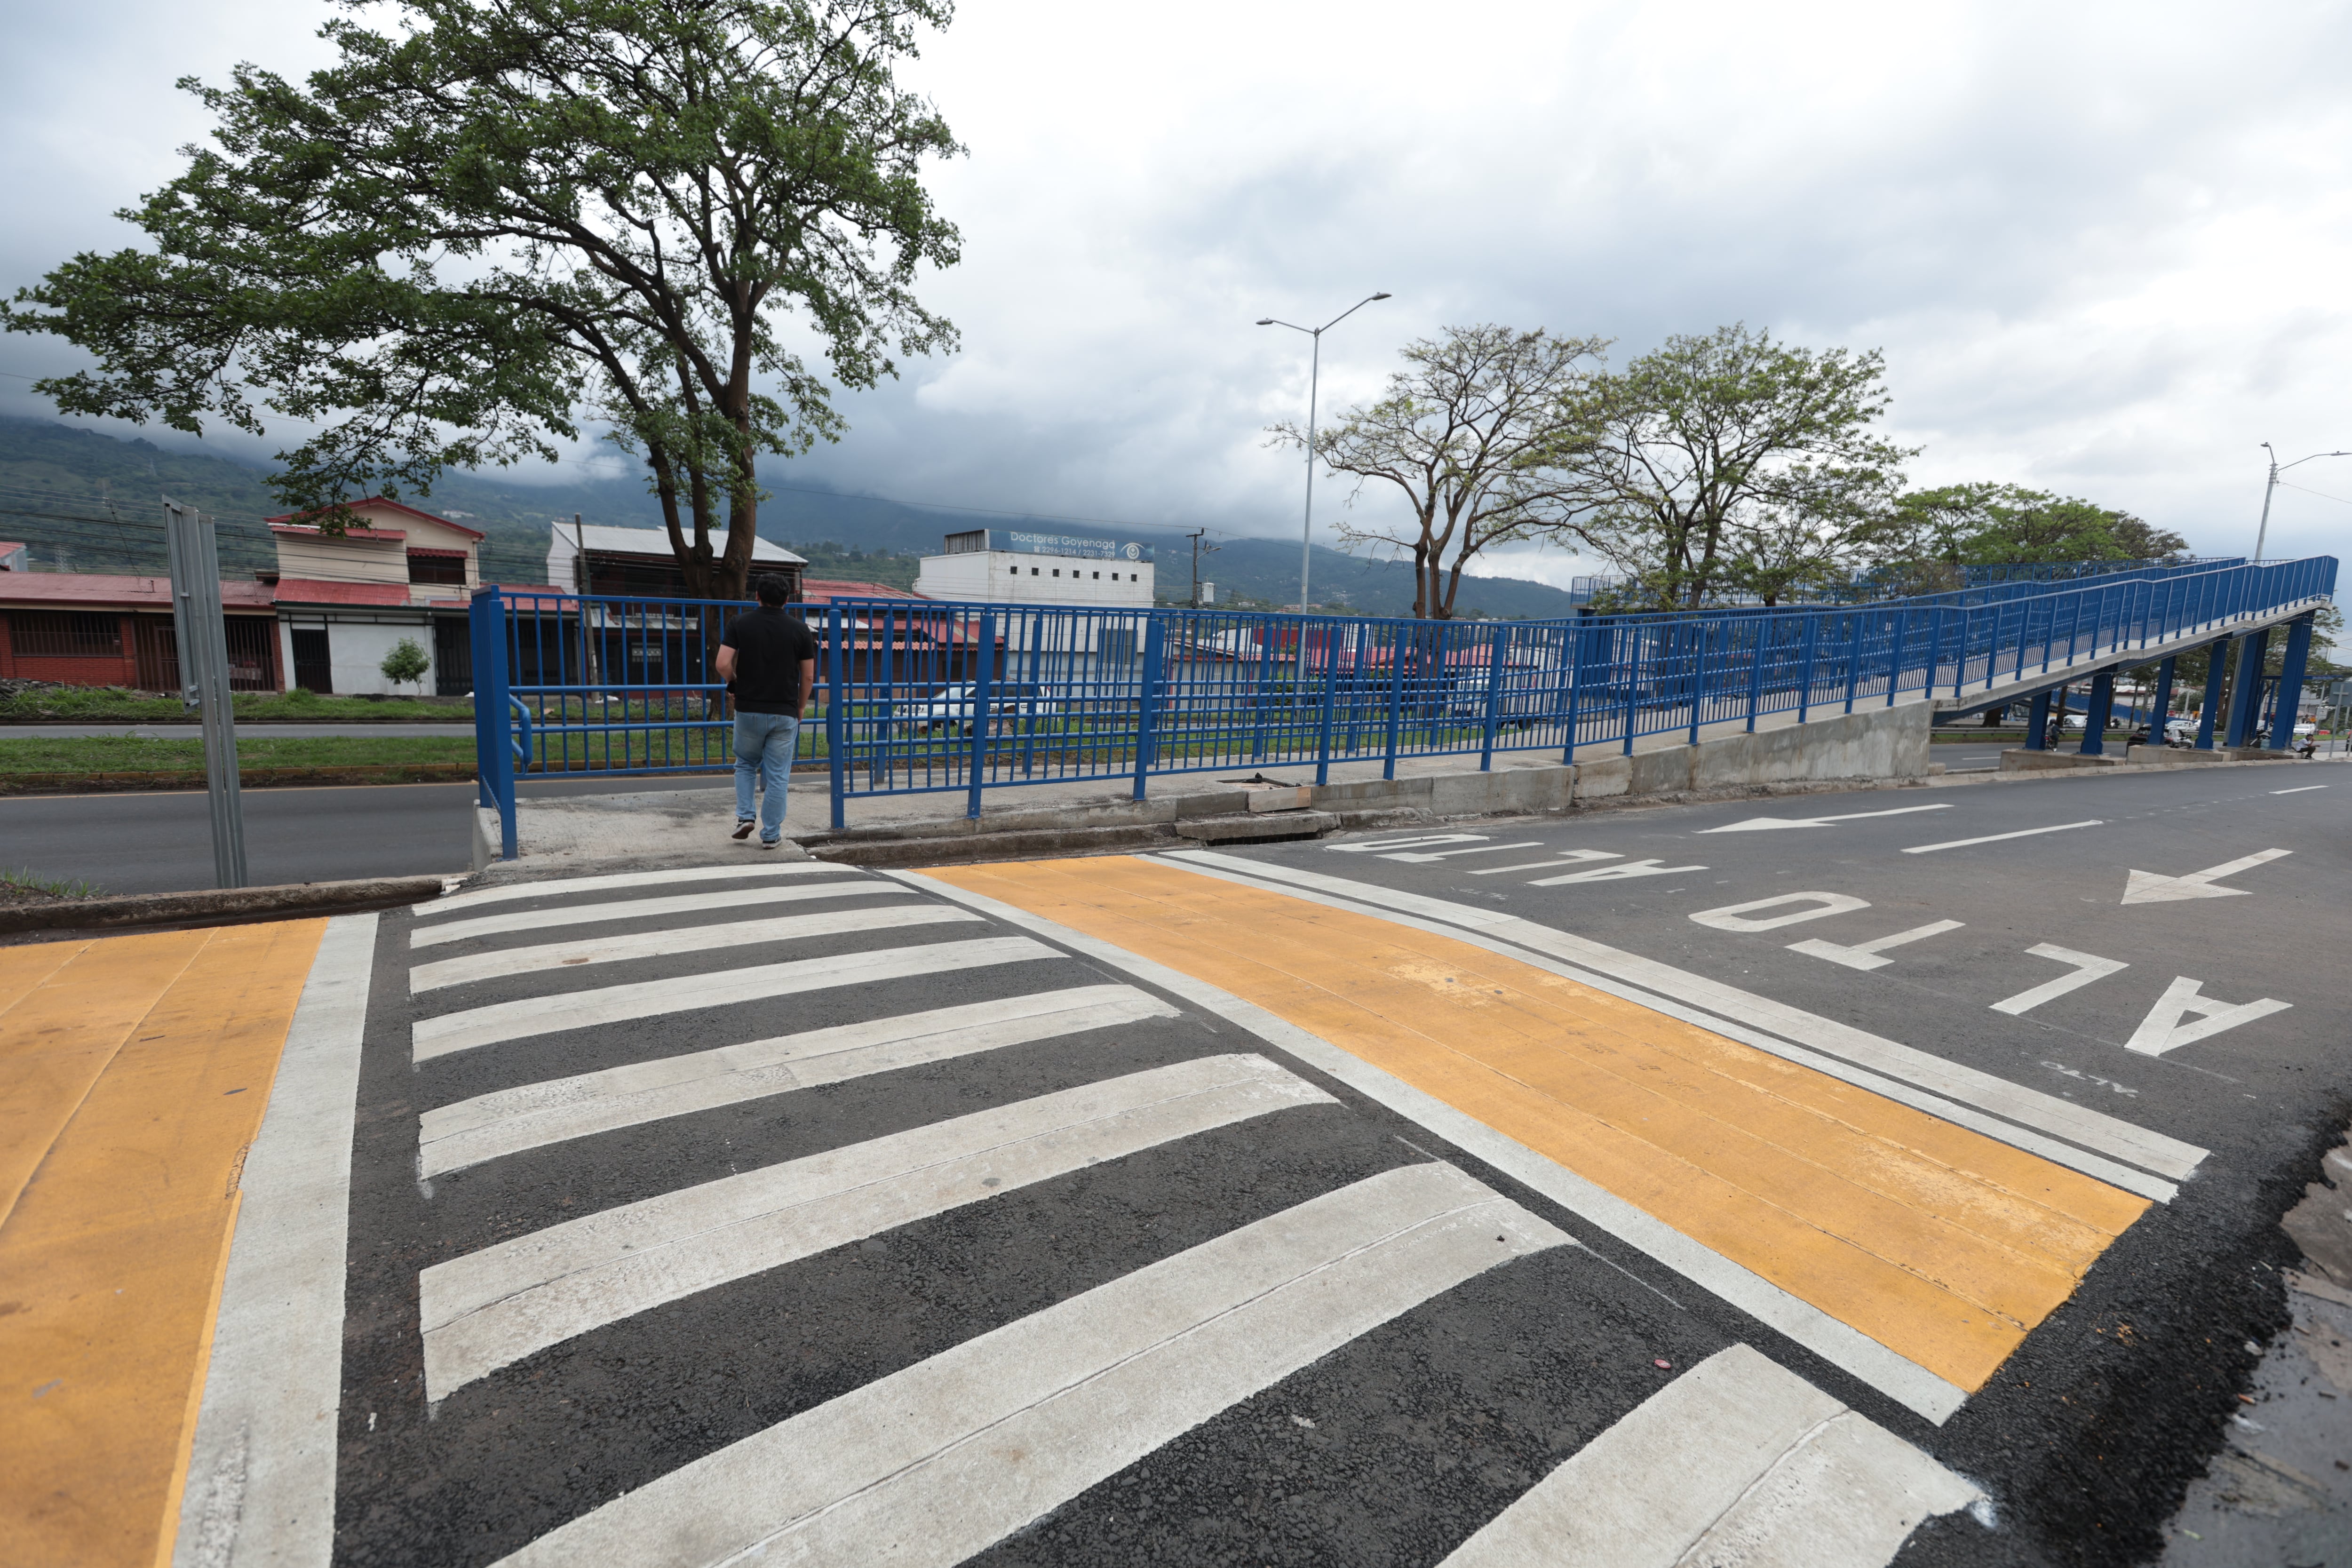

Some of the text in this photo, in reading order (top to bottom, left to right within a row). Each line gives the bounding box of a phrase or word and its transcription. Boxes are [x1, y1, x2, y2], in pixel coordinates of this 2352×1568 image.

[1010, 532, 1115, 549] Doctores Goyenaga
[1042, 546, 1076, 555] 2296-1214
[1325, 833, 1710, 886] ALTO
[1688, 891, 2294, 1058] ALTO
